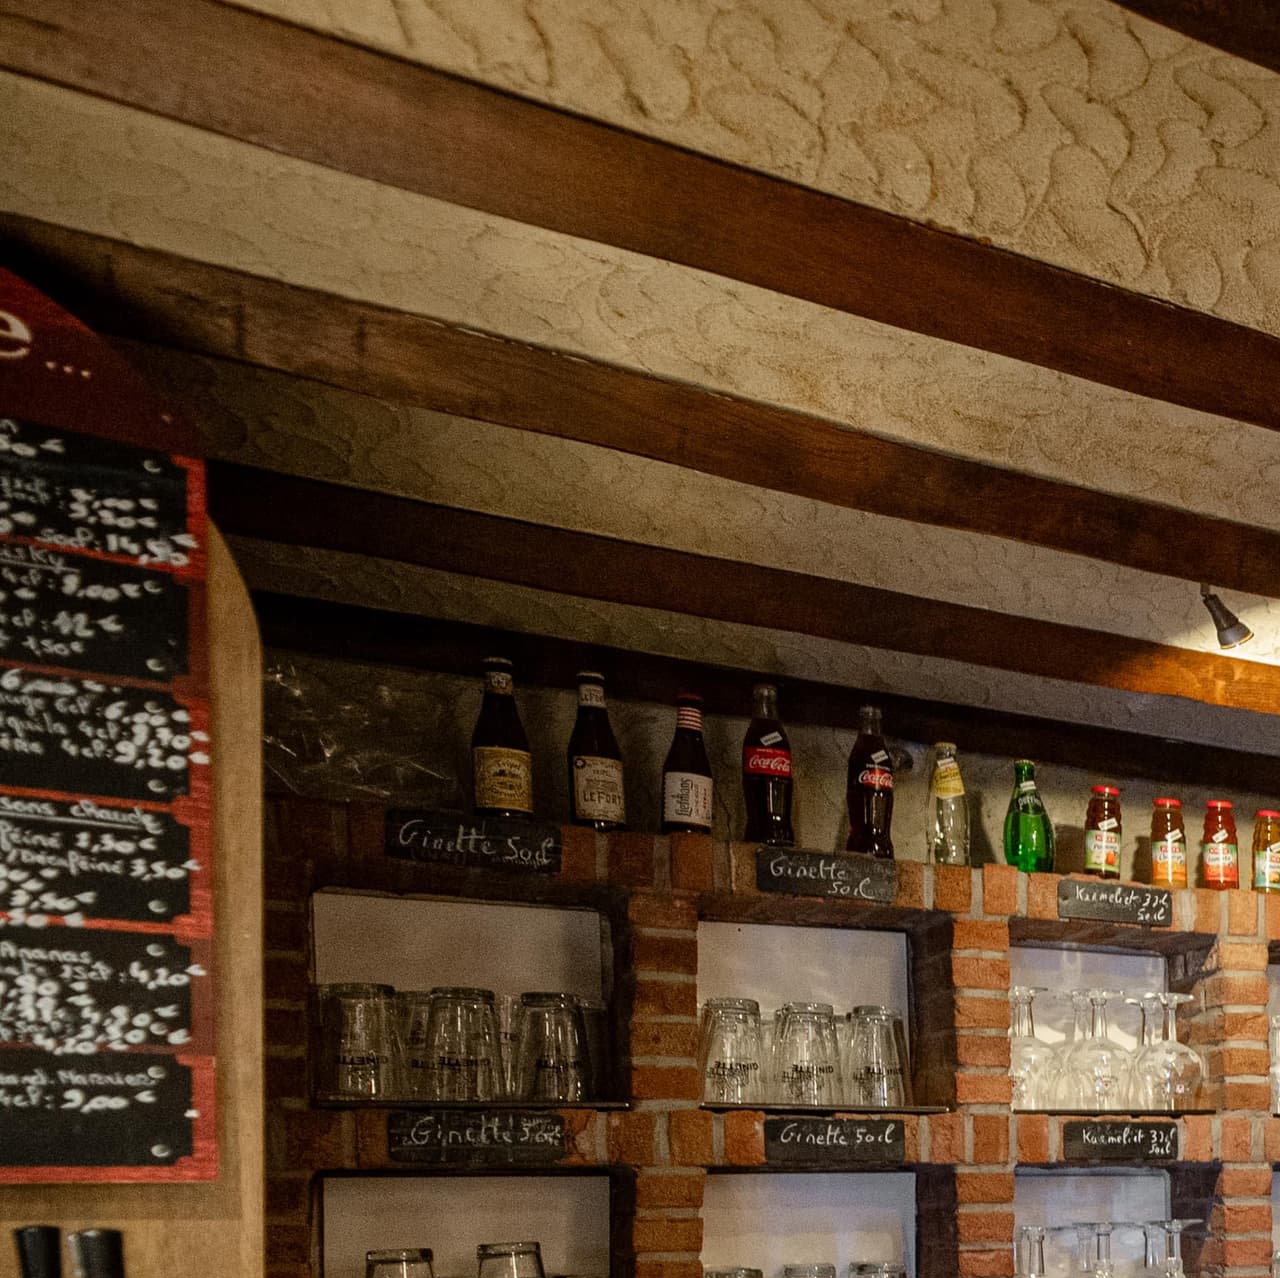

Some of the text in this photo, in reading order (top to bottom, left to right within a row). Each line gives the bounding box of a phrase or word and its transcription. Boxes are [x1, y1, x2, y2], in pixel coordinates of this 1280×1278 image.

[398, 818, 497, 857] Ginette
[770, 855, 848, 880] Ginette
[780, 1120, 848, 1147] Ginette
